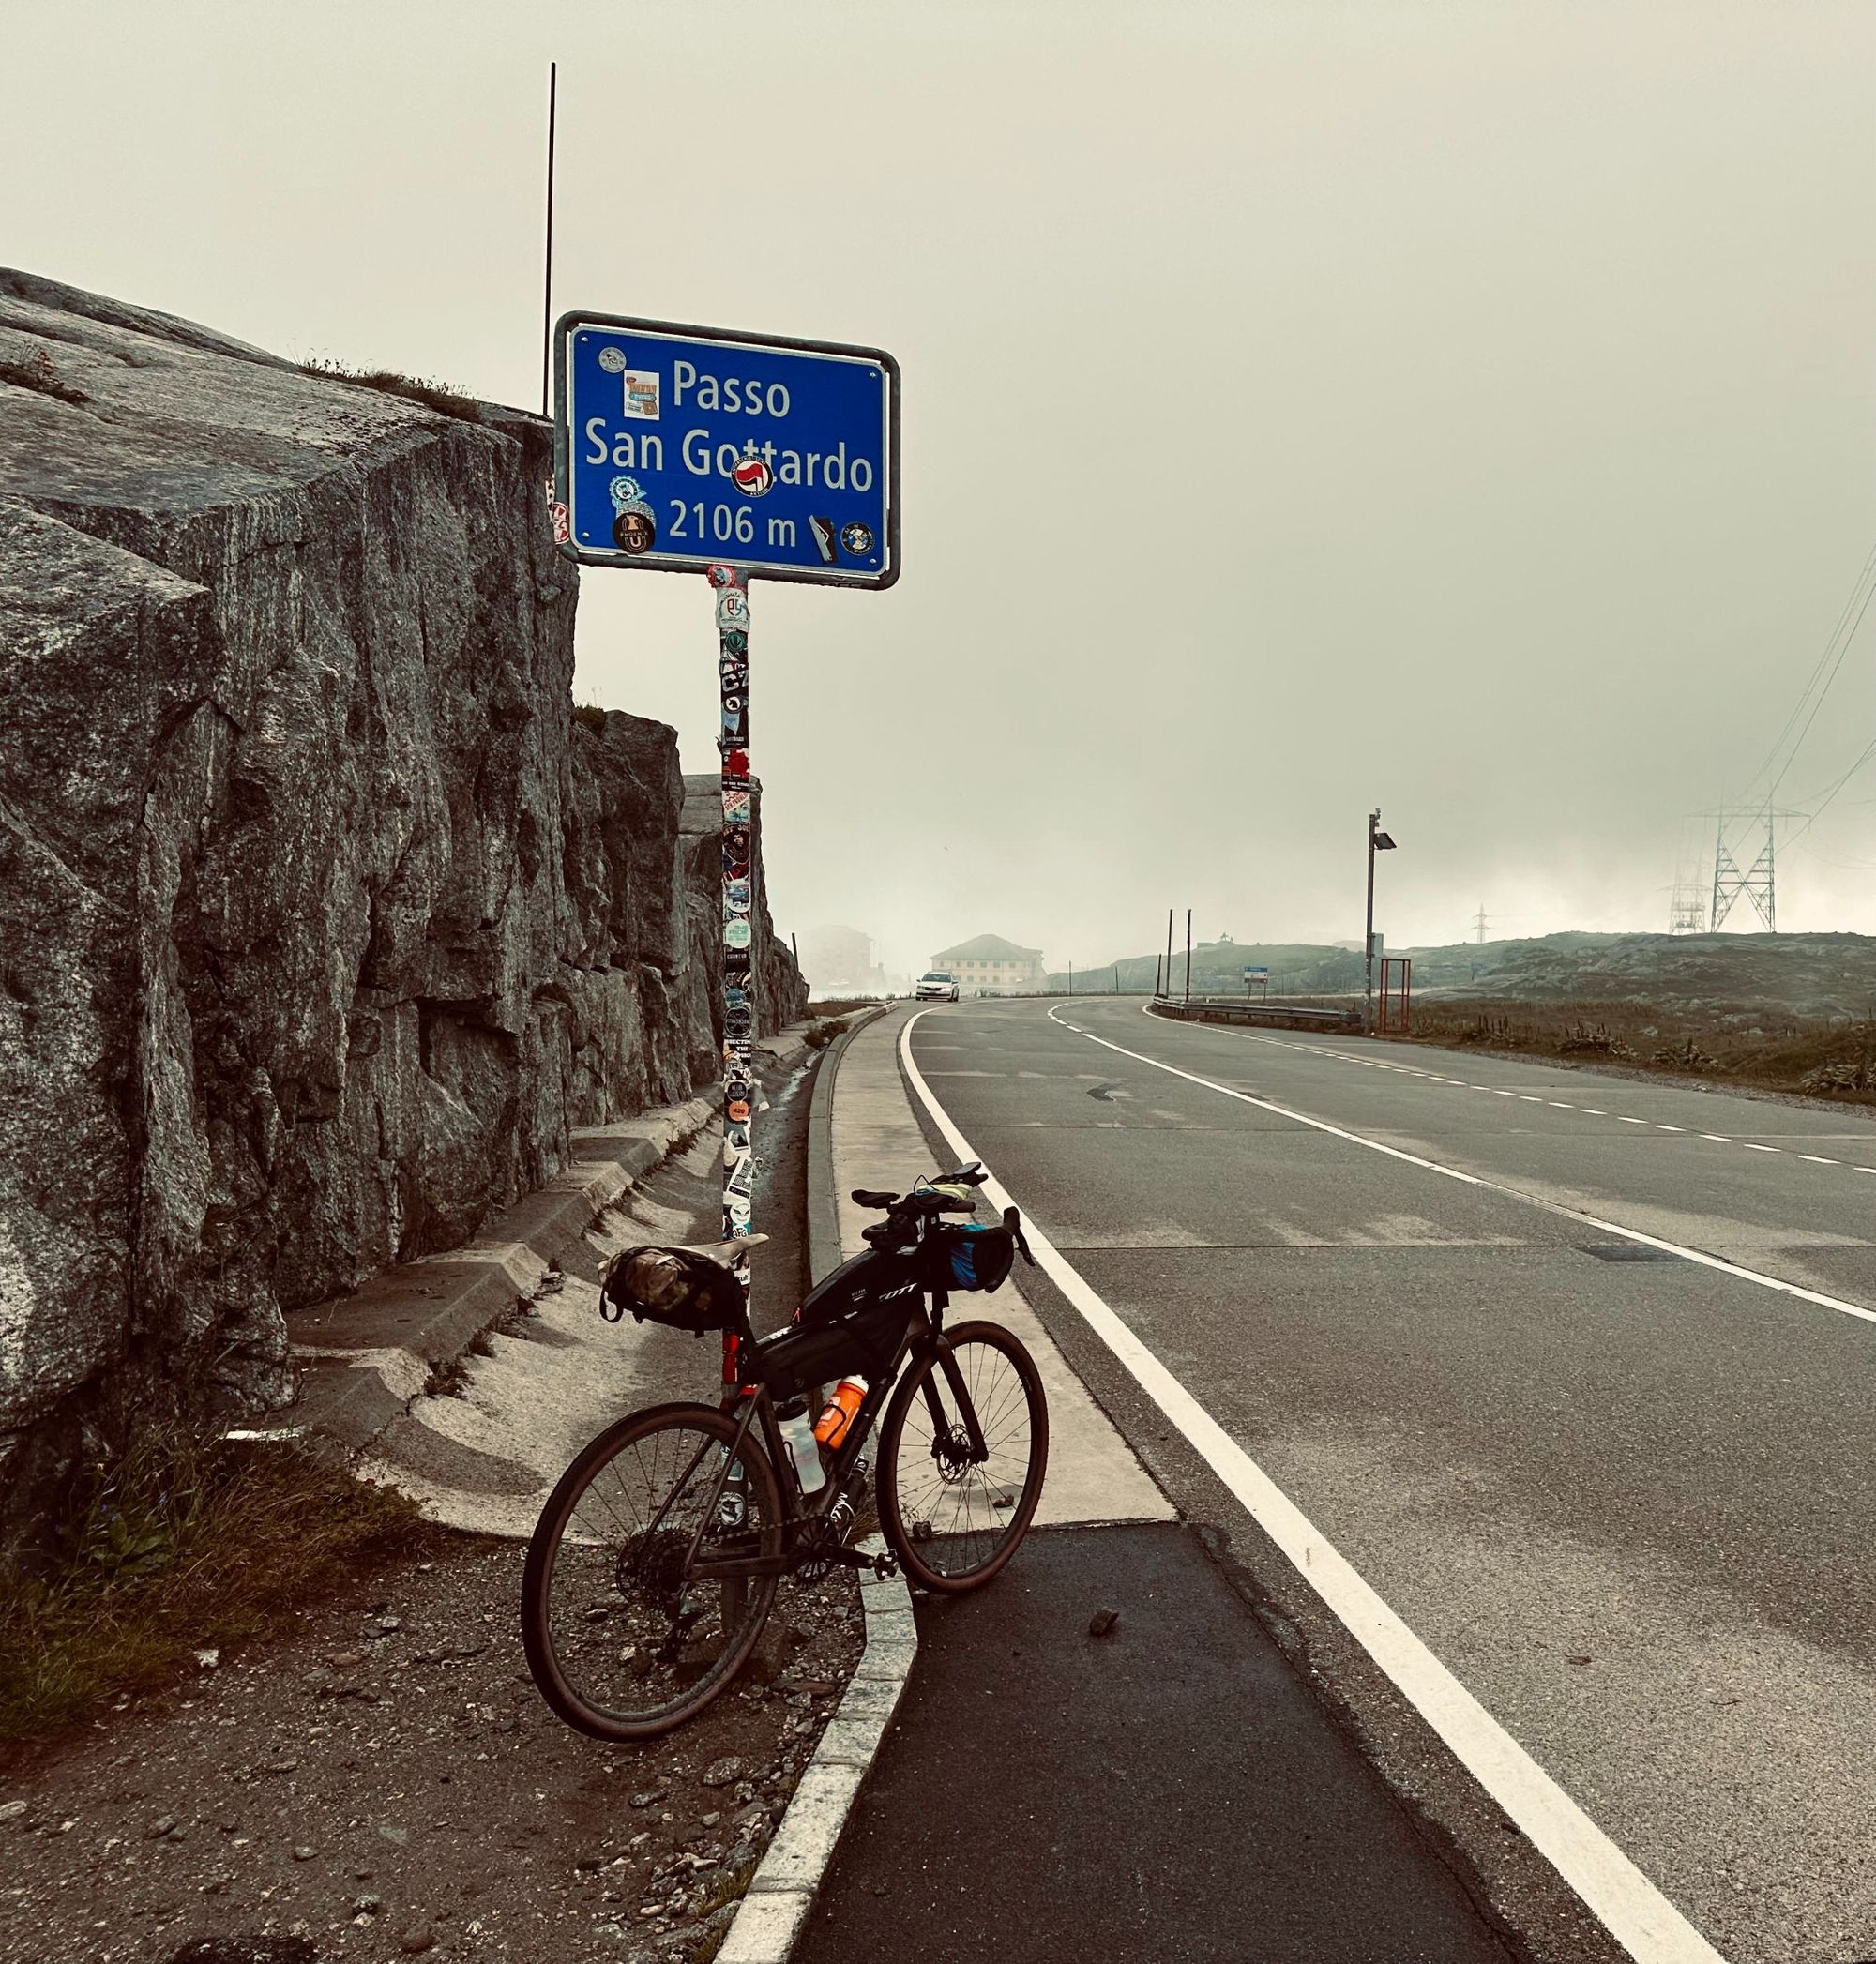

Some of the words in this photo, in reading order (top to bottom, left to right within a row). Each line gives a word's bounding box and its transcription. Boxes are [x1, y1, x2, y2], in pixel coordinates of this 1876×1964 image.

[673, 360, 790, 418] Passo
[585, 417, 663, 471] San
[682, 429, 873, 492] Gottardo
[669, 499, 754, 543] 2106
[768, 518, 796, 548] m
